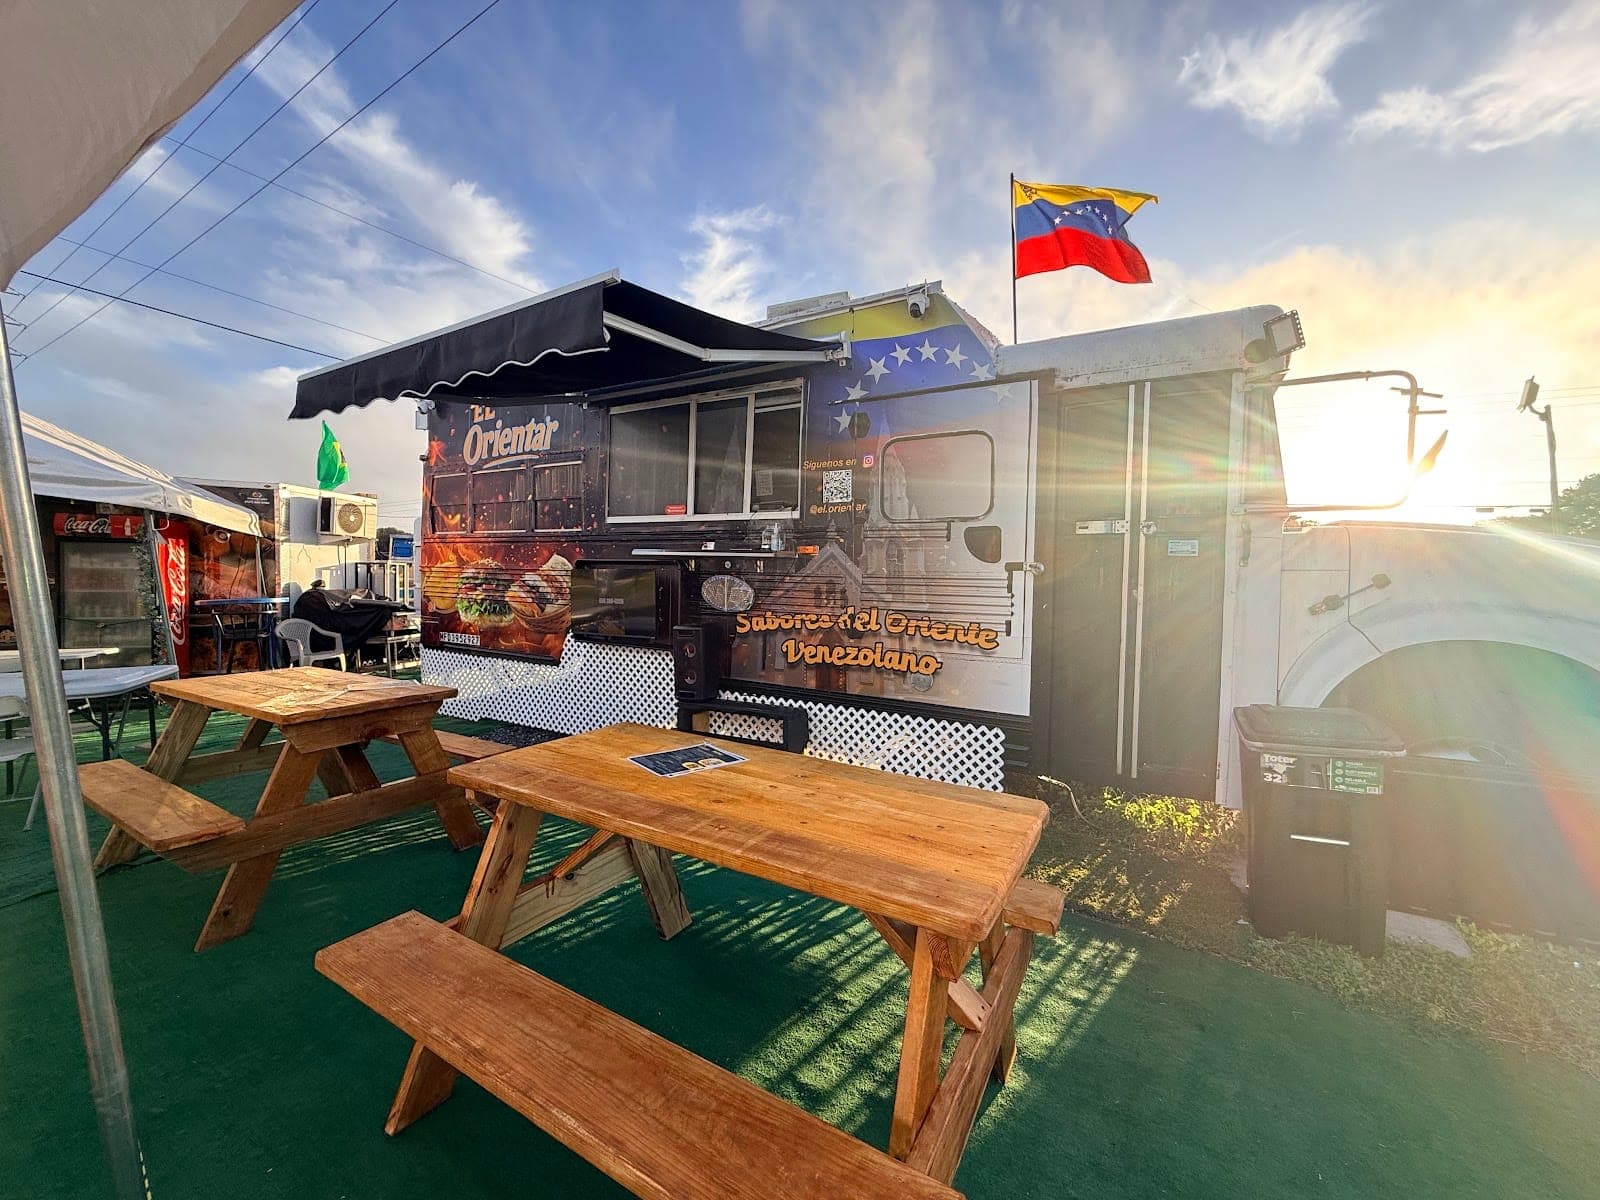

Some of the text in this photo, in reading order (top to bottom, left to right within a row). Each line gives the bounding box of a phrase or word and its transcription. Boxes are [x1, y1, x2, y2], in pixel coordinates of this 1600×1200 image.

[463, 416, 559, 466] Orientar
[845, 458, 857, 466] en
[735, 606, 999, 650] Sabores del Oriente
[781, 638, 942, 675] Venezolano
[1263, 773, 1282, 783] 32
